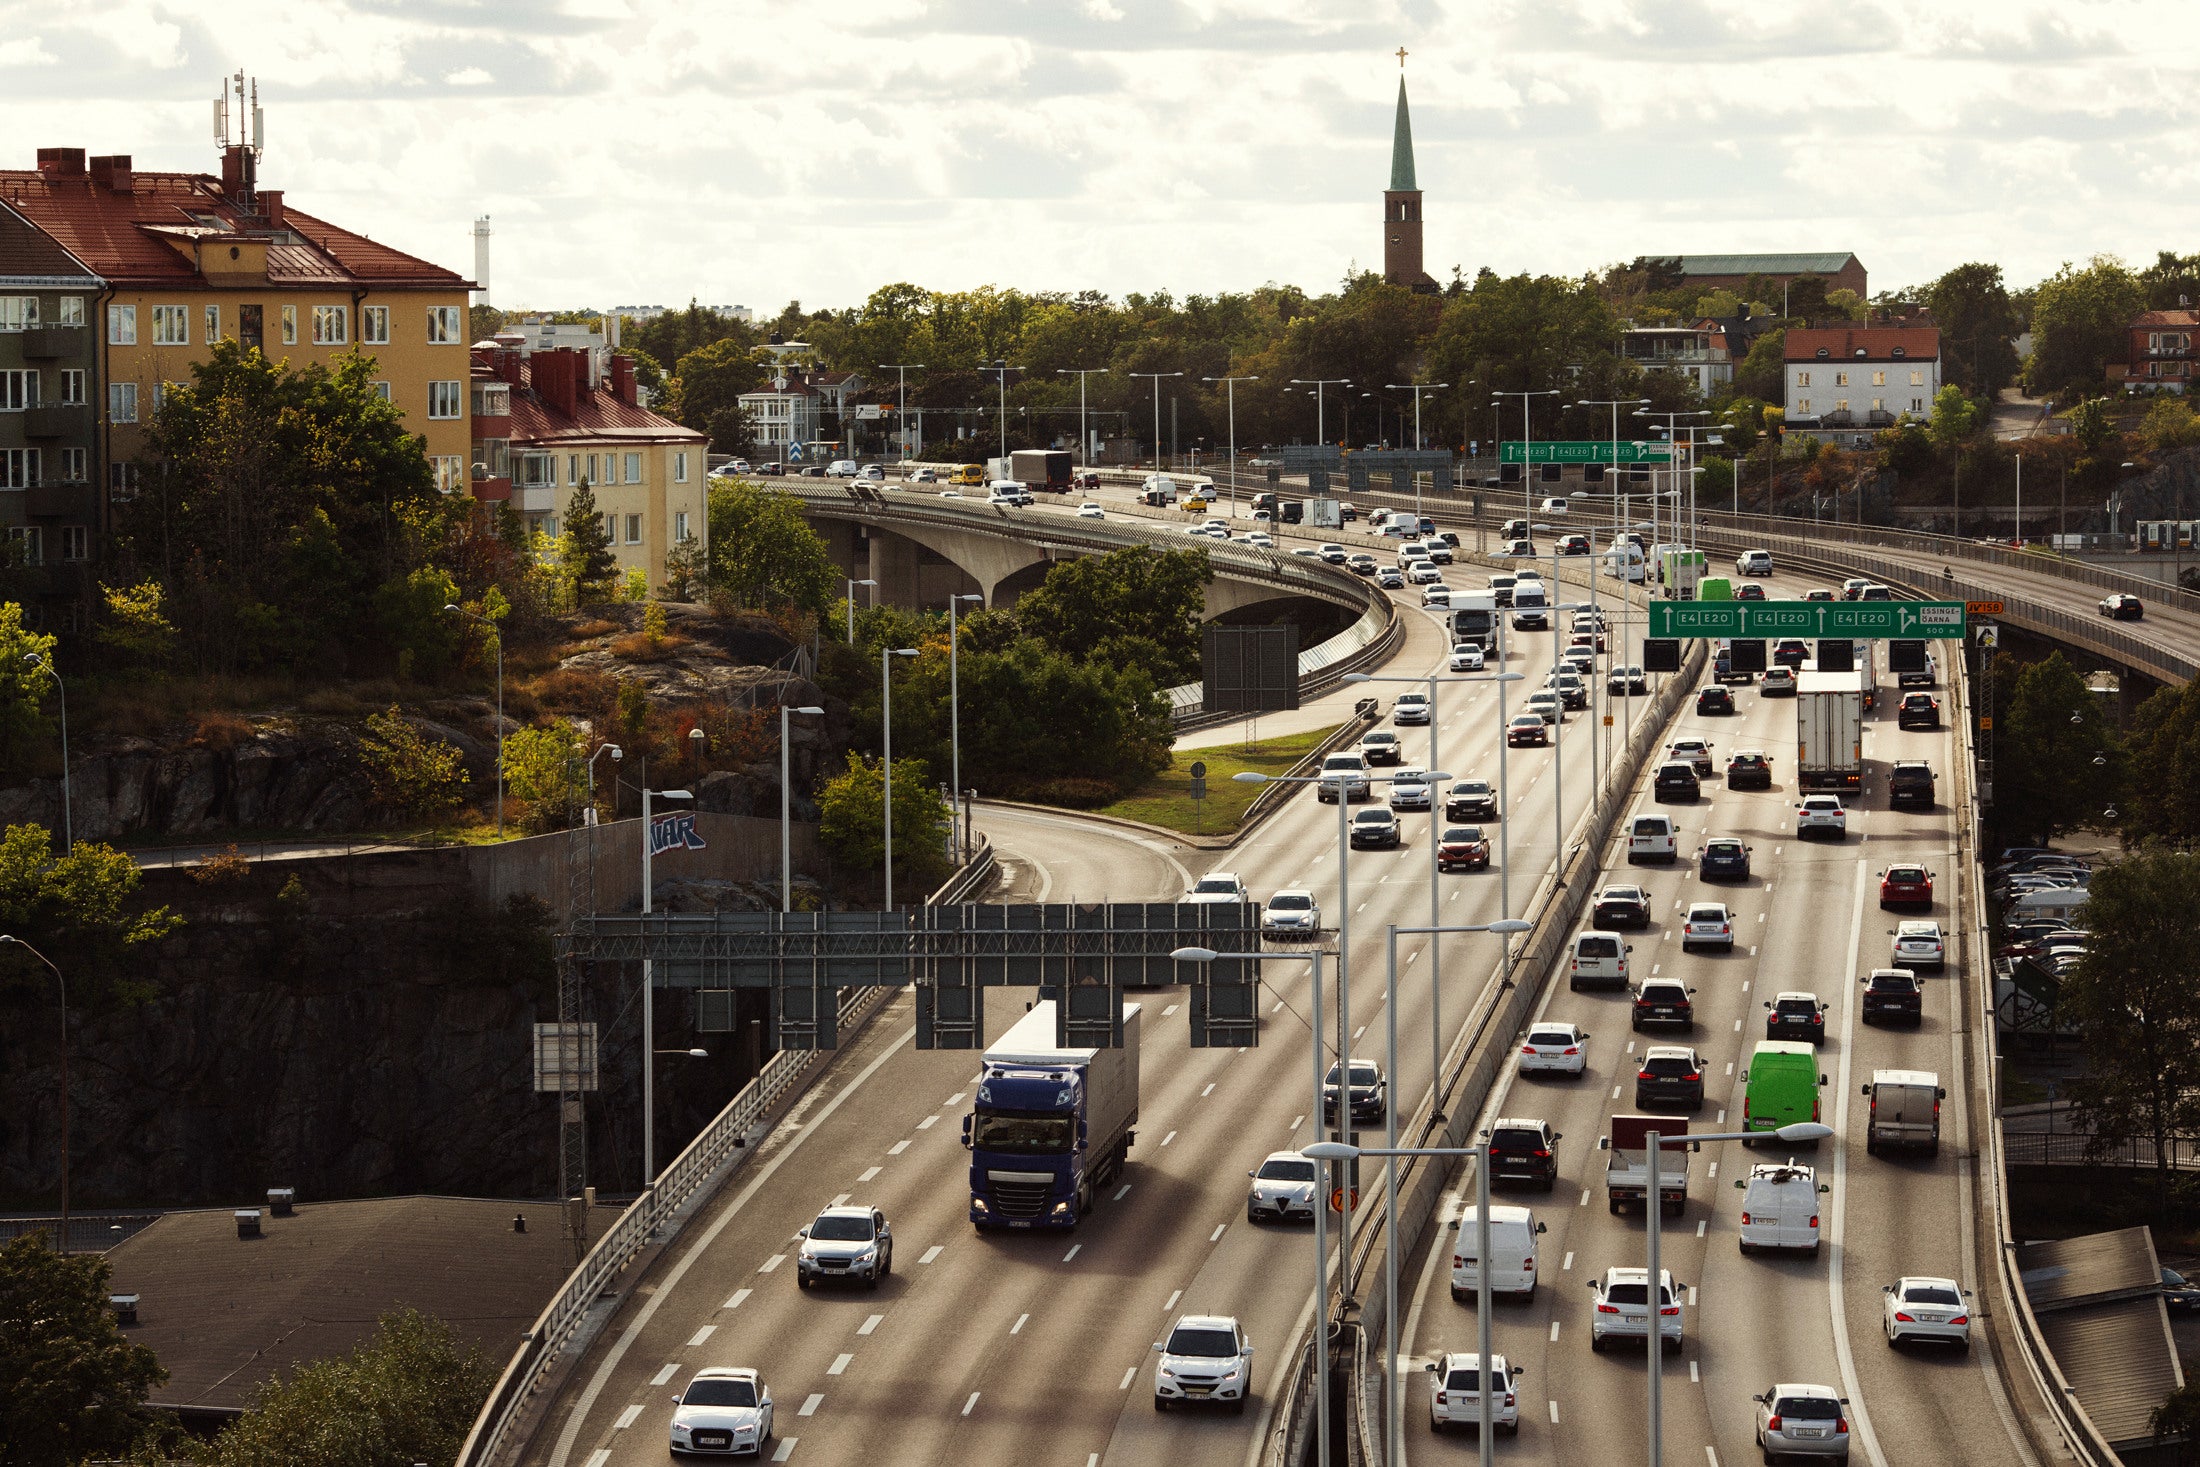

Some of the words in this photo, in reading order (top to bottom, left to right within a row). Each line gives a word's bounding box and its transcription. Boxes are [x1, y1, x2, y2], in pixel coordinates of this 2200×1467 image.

[1921, 607, 1960, 615] ESSINGE-
[1681, 613, 1696, 623] E4
[1704, 613, 1728, 623] E20
[1757, 613, 1772, 623] E4
[1780, 613, 1805, 623] E20
[1838, 614, 1853, 623] E4
[1861, 614, 1886, 623] E20
[1921, 615, 1950, 623] ÖARNA
